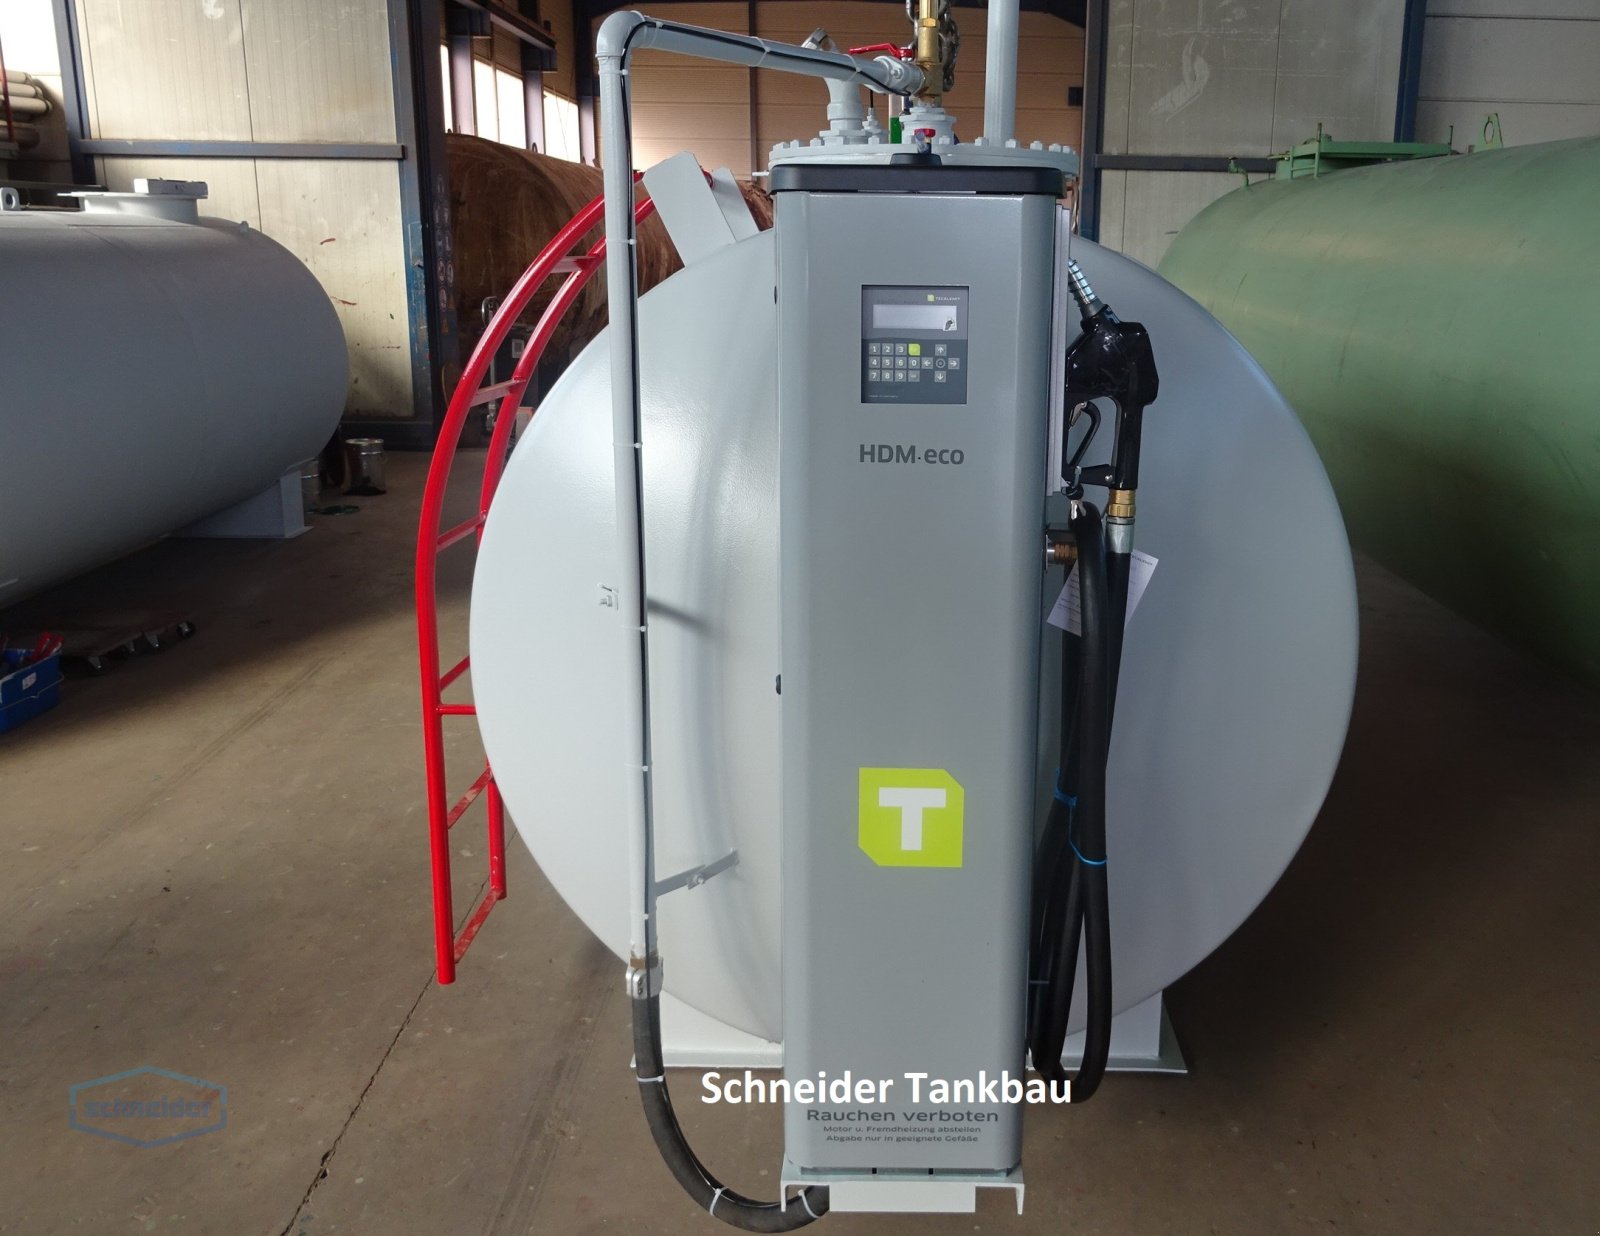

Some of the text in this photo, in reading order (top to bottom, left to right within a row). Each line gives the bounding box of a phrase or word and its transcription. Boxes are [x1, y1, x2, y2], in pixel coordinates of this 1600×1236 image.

[879, 787, 946, 851] T
[807, 1109, 999, 1122] Rauchen verboten
